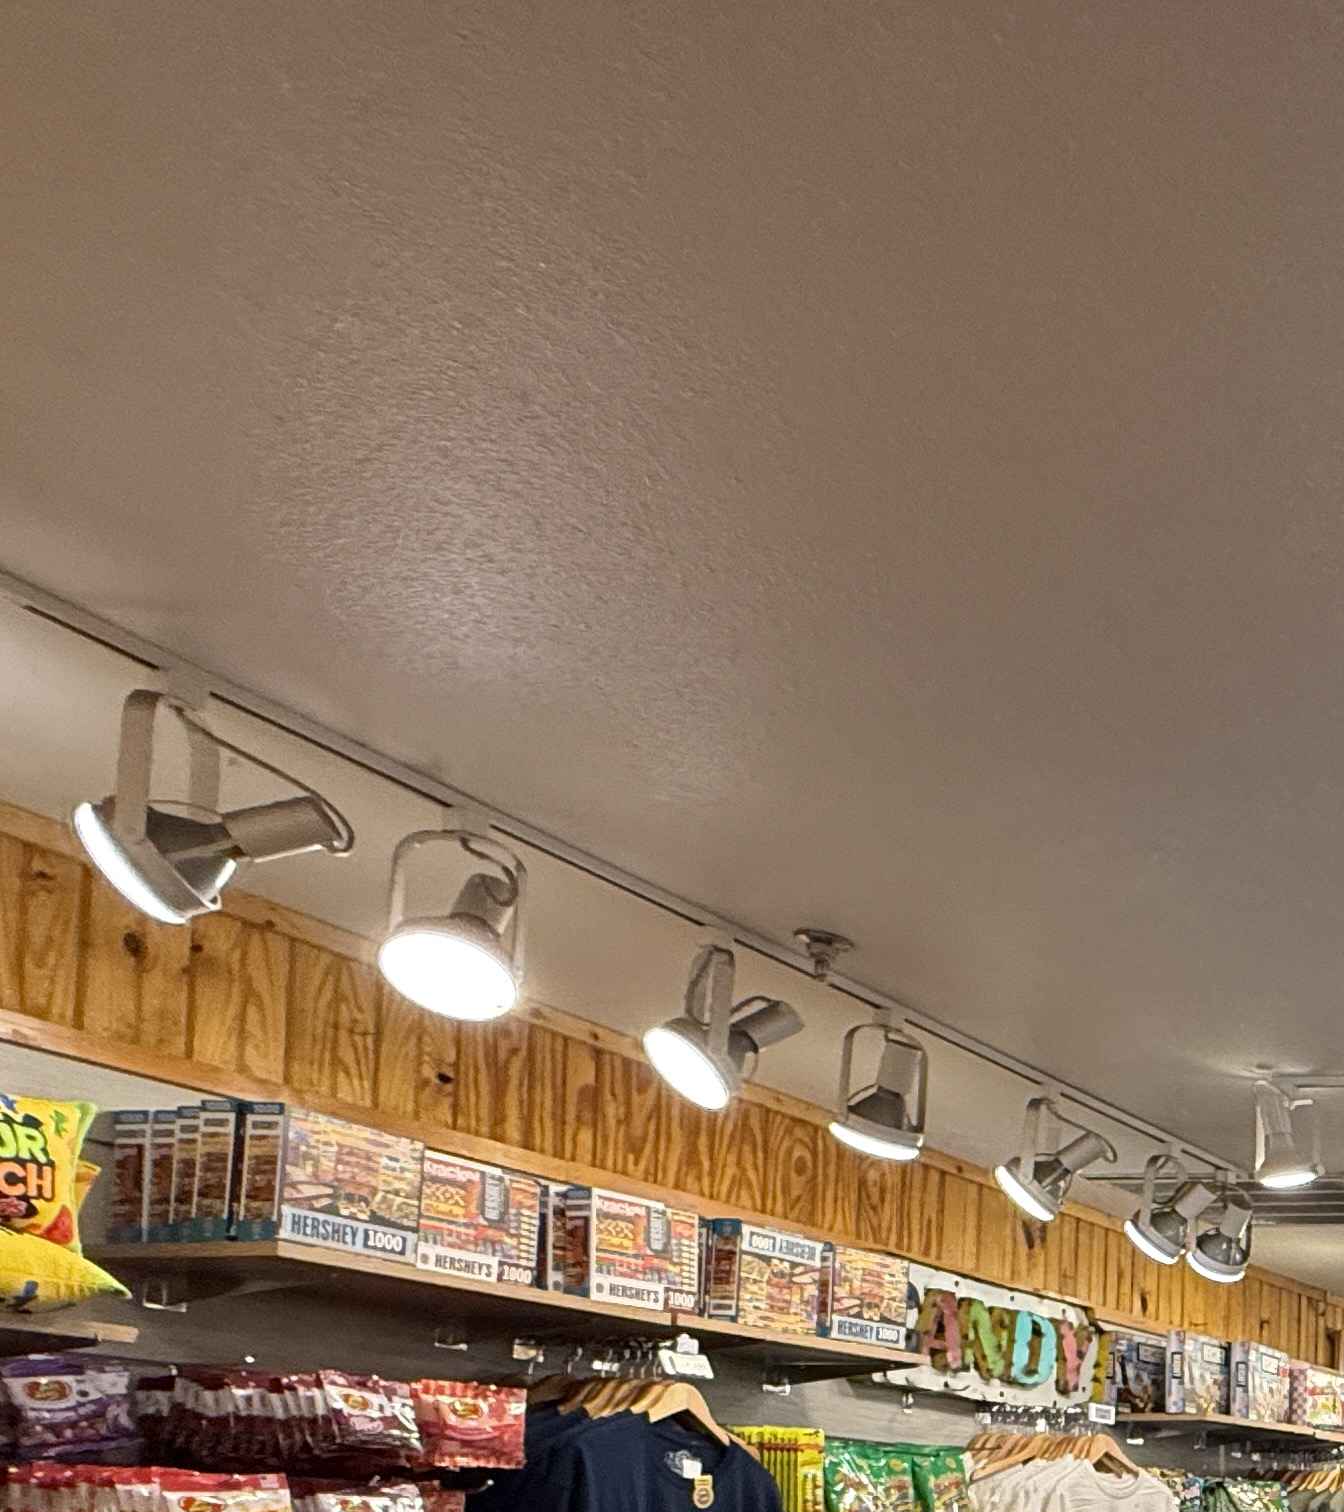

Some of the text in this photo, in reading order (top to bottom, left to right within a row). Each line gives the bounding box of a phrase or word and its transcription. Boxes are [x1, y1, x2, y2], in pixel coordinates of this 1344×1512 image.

[291, 1213, 403, 1252] HERSHEY 1000
[435, 1254, 532, 1284] HERSHEY'S 1000
[668, 1290, 695, 1308] 1000
[914, 1286, 1093, 1396] ANDY
